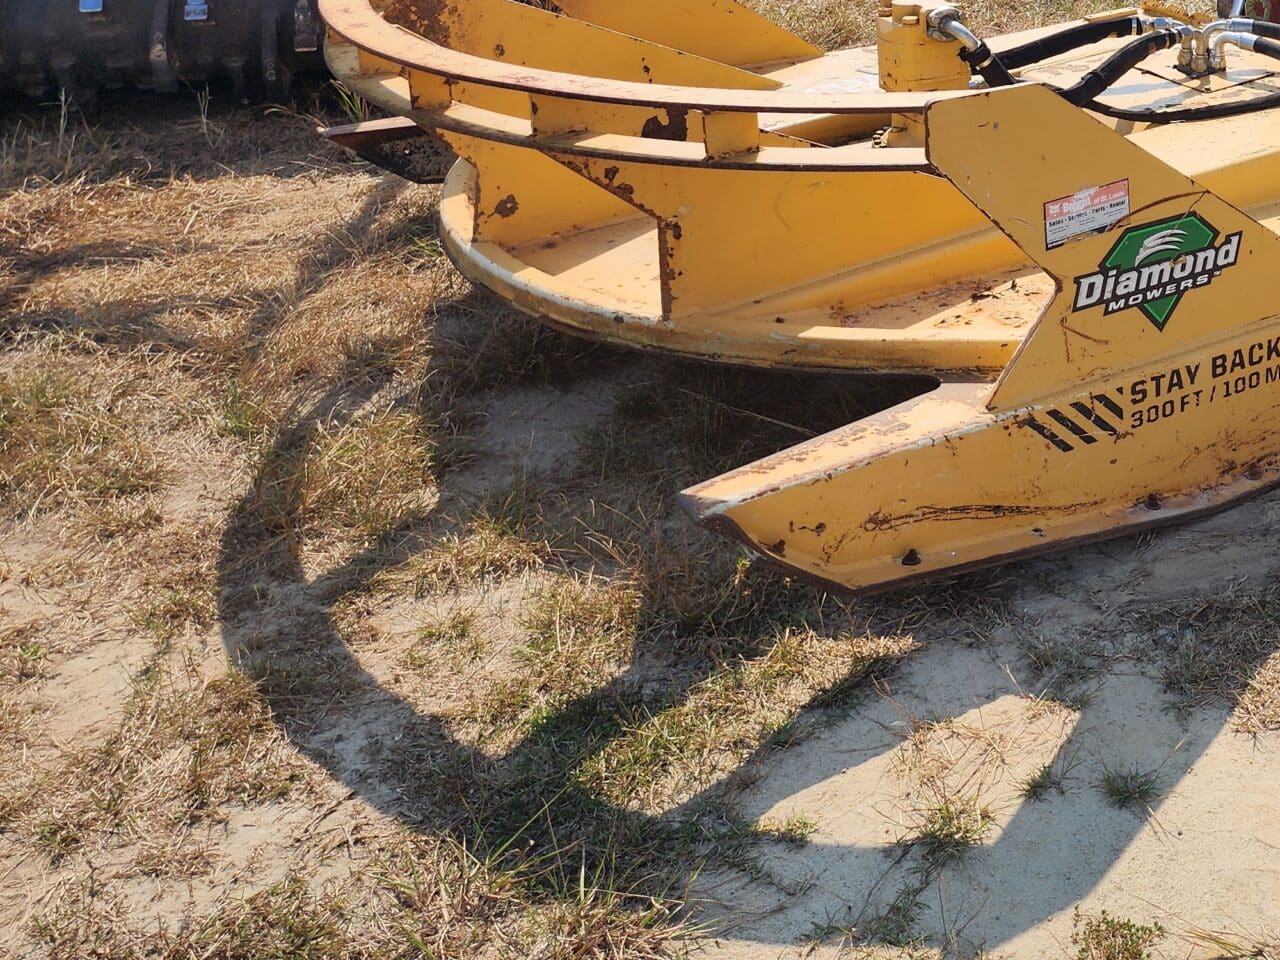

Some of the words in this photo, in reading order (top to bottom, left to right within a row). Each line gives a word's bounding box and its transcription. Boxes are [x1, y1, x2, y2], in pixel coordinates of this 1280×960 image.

[1048, 217, 1064, 227] Sales
[1068, 211, 1088, 221] Service
[1091, 206, 1106, 215] Parts
[1093, 197, 1100, 205] of
[1076, 234, 1240, 308] Diamond
[1108, 274, 1209, 312] MOWERS
[1130, 362, 1200, 405] STAY
